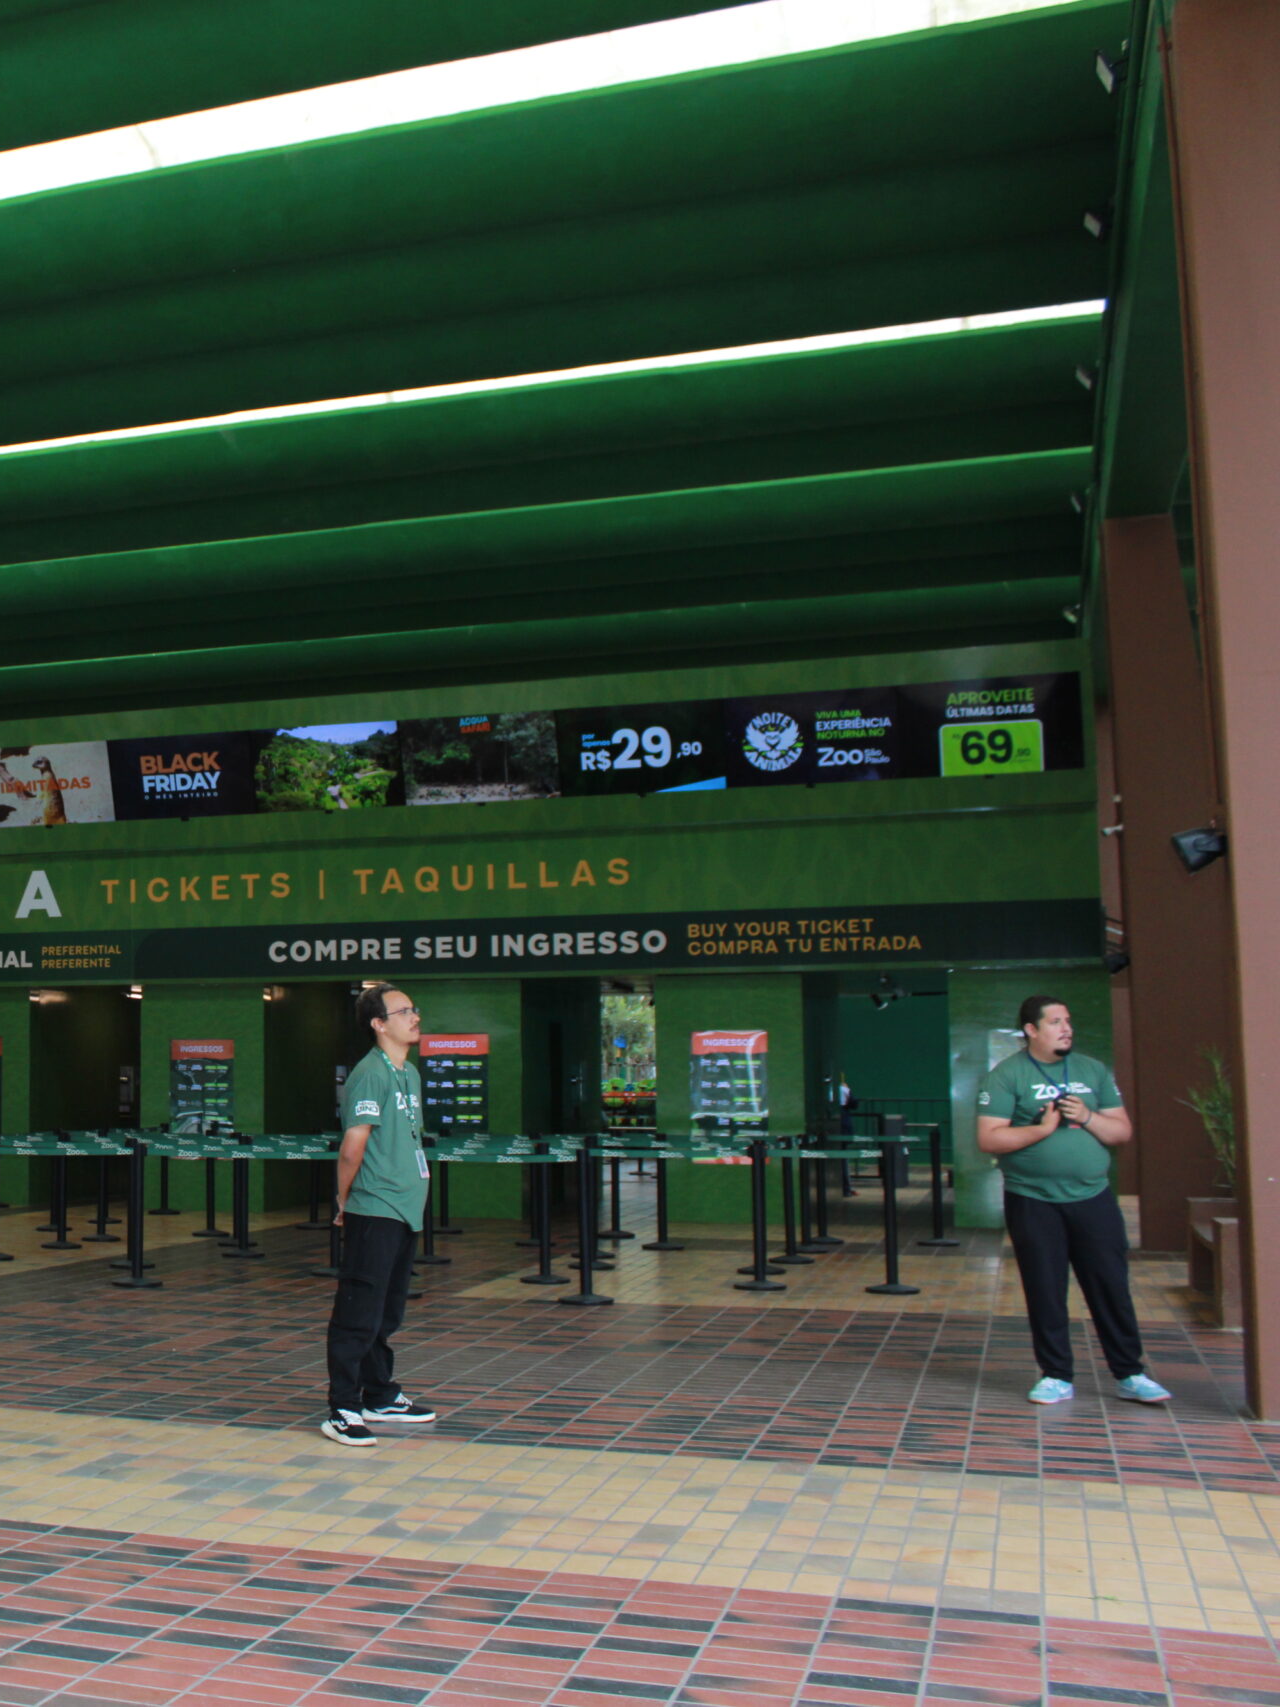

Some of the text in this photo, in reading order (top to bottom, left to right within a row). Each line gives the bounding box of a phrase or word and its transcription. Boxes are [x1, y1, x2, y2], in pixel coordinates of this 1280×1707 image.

[946, 688, 1035, 706] APROVEITE
[751, 711, 791, 727] NOITE
[815, 709, 862, 719] VIVA UMA
[945, 703, 1035, 718] ÚLTIMAS DATAS
[459, 715, 489, 727] ACQUA
[815, 716, 892, 732] EXPERIÊNCIA
[816, 728, 886, 740] NOTURNA NO
[960, 729, 1013, 765] 69
[139, 751, 221, 774] BLACK
[744, 747, 803, 772] ANIMAL
[817, 746, 864, 767] Zoo
[142, 771, 221, 793] FRIDAY
[100, 871, 292, 904] TICKETS
[353, 857, 630, 896] TAQUILLAS
[687, 918, 874, 938] BUY YOUR TICKET
[41, 944, 122, 956] PREFERENTIAL
[268, 929, 668, 963] COMPRE SEU INGRESSO
[687, 935, 922, 956] COMPRA TU ENTRADA
[41, 958, 111, 969] PREFERENTE
[180, 1045, 224, 1053] INGRESSOS
[429, 1040, 477, 1048] INGRESSOS
